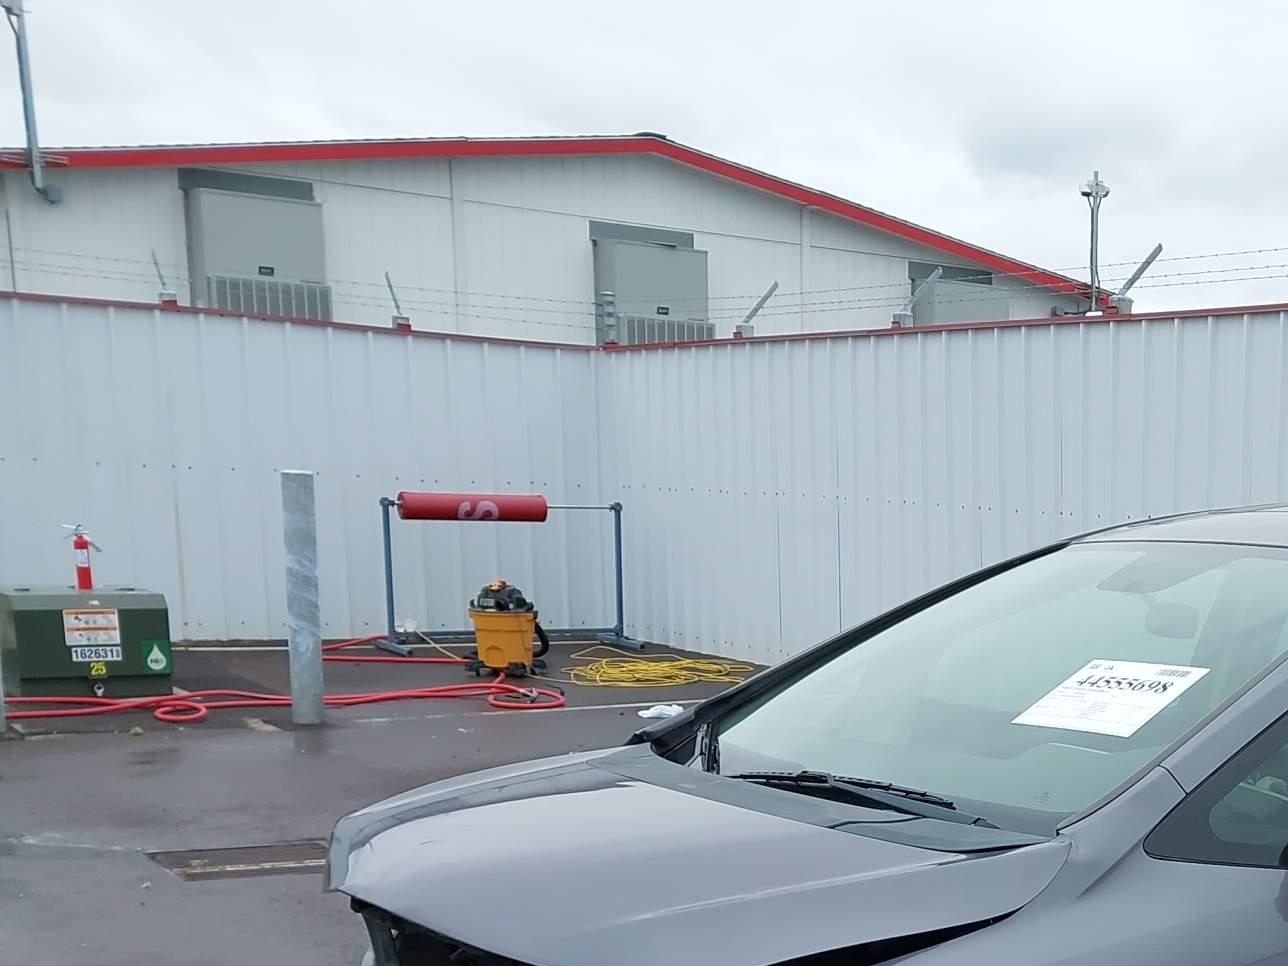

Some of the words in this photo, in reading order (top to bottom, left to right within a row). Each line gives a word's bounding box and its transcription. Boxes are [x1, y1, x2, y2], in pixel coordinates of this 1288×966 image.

[73, 648, 114, 659] 162631
[90, 662, 106, 675] 25
[1077, 675, 1174, 693] 44555698
